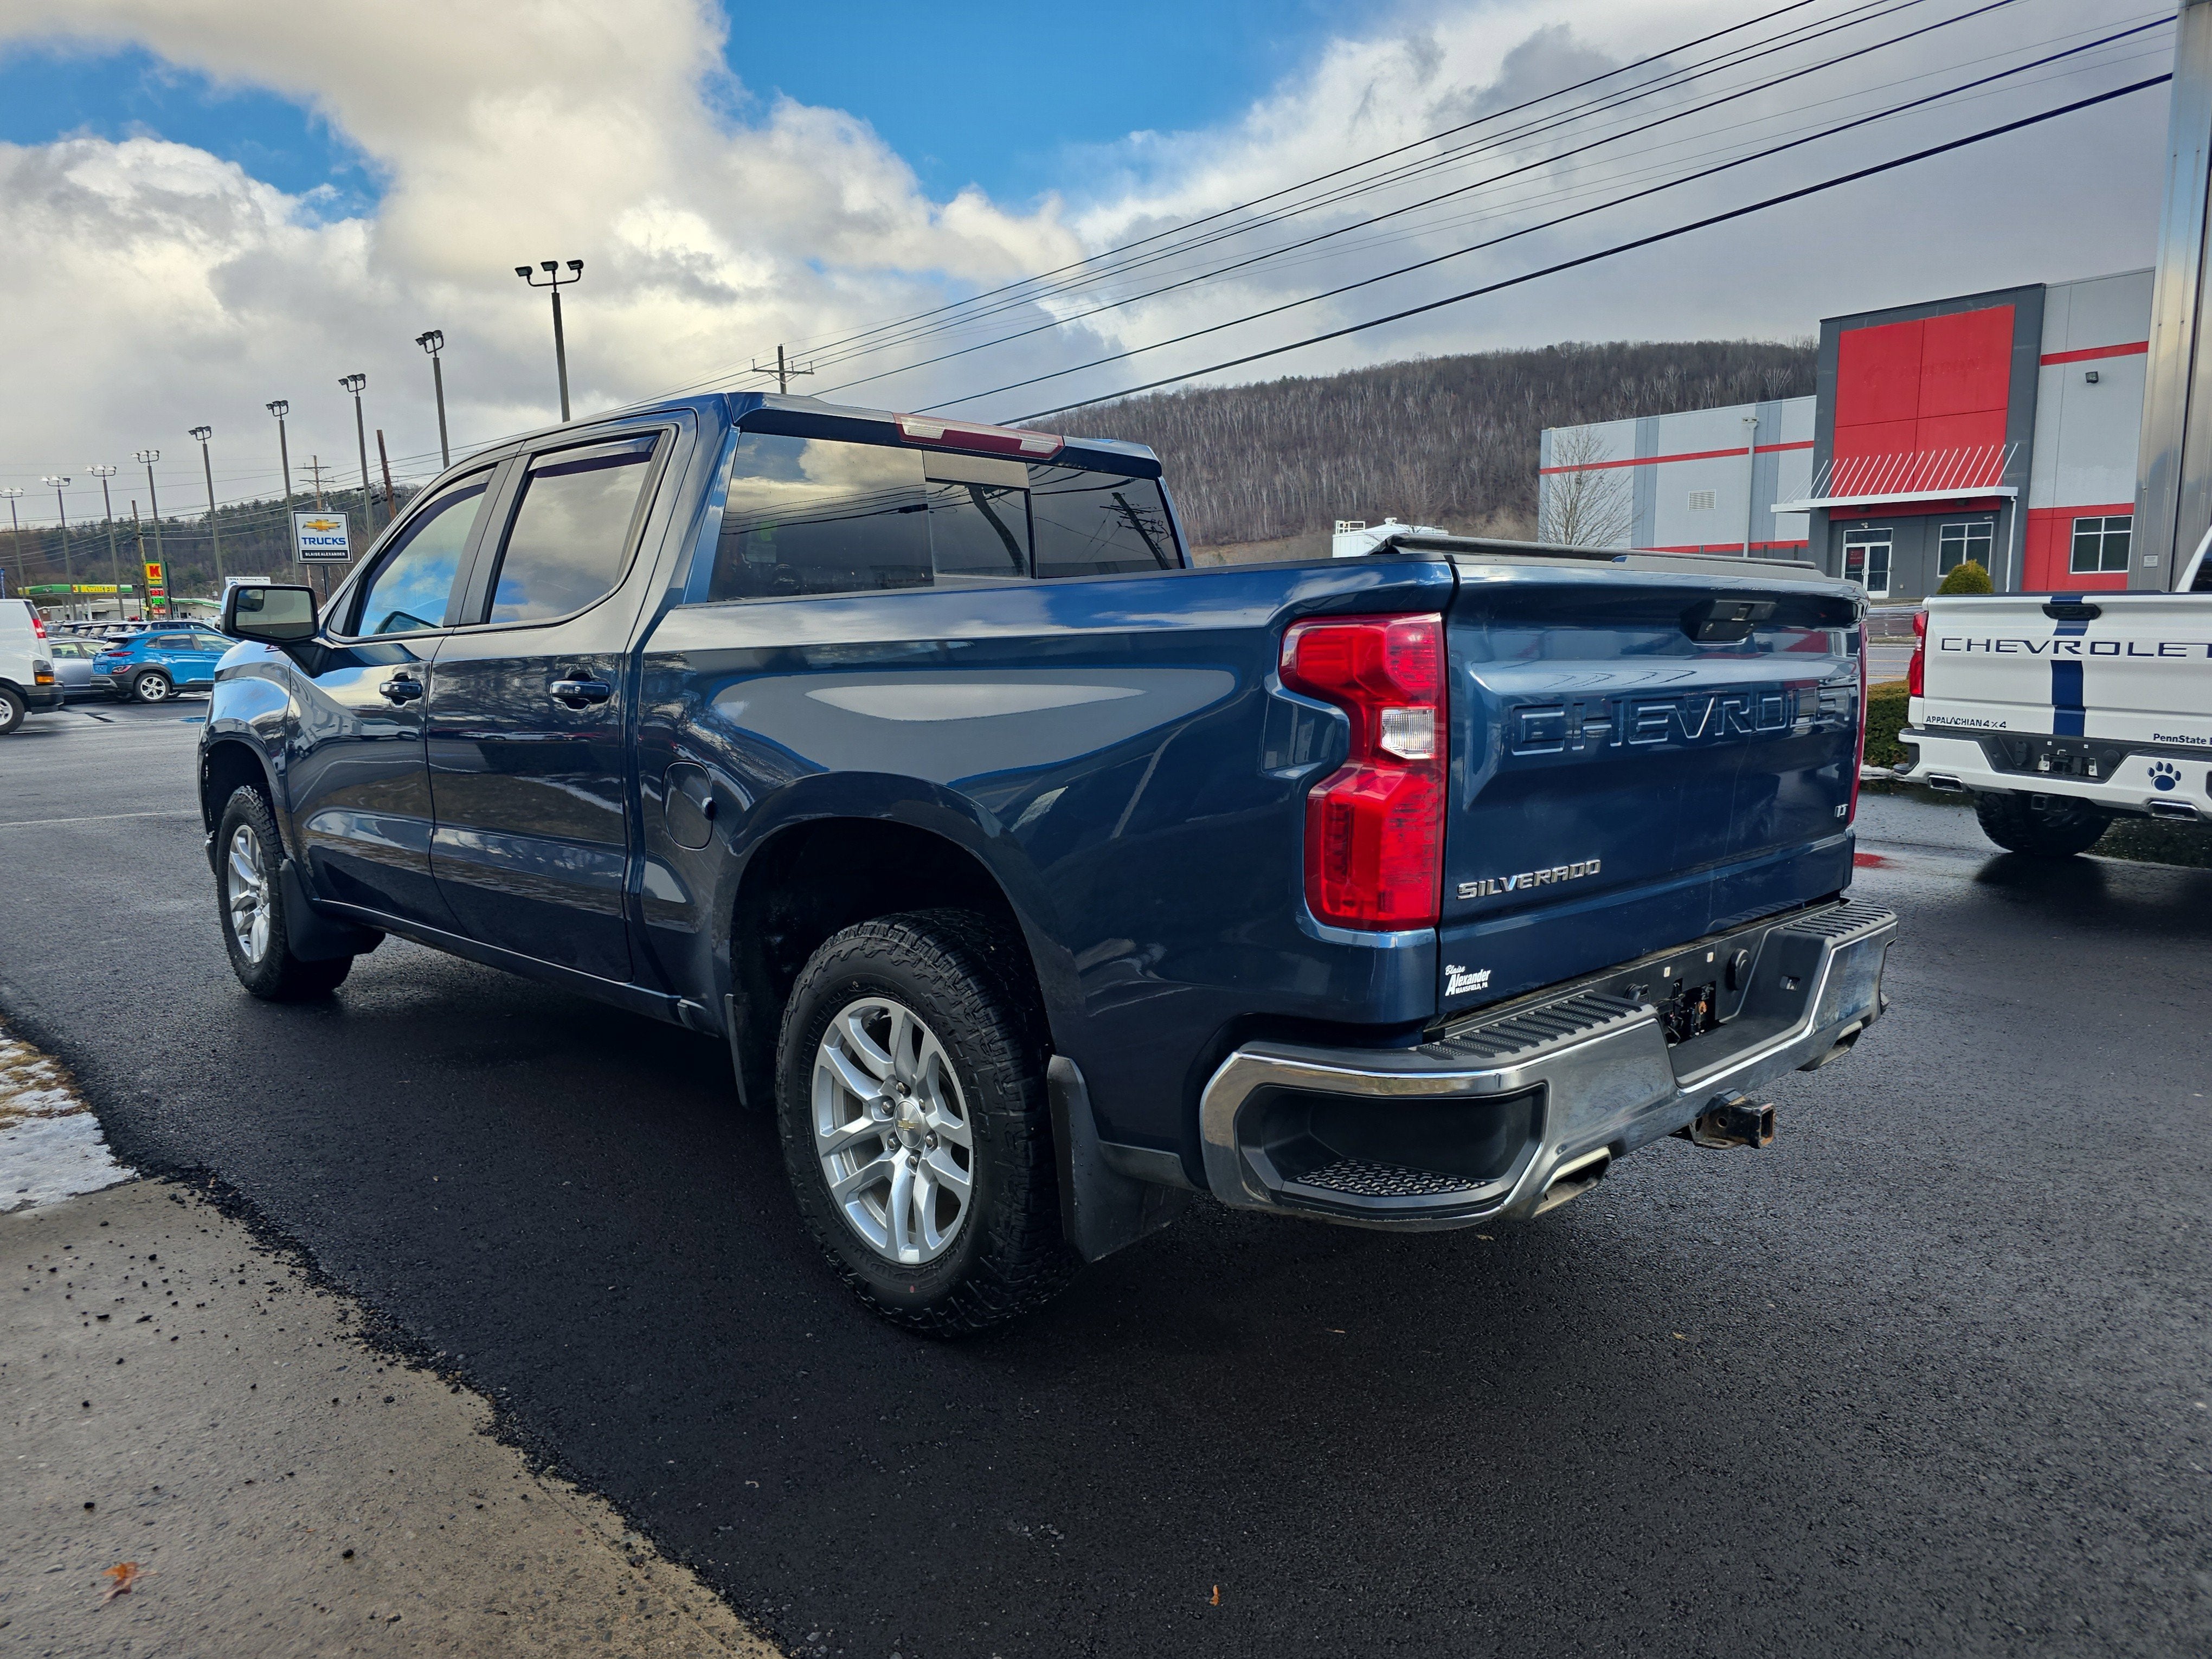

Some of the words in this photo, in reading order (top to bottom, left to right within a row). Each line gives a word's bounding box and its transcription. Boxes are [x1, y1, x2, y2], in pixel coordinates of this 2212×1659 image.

[301, 537, 346, 545] TRUCKS
[149, 565, 162, 577] K
[1512, 684, 1859, 756] CHEVROLET
[1926, 716, 1982, 726] APPALACHIAN
[2153, 733, 2207, 744] PennState
[1456, 859, 1601, 900] SILVERADO
[1445, 964, 1465, 976] Blaise
[1445, 969, 1491, 996] Alexander
